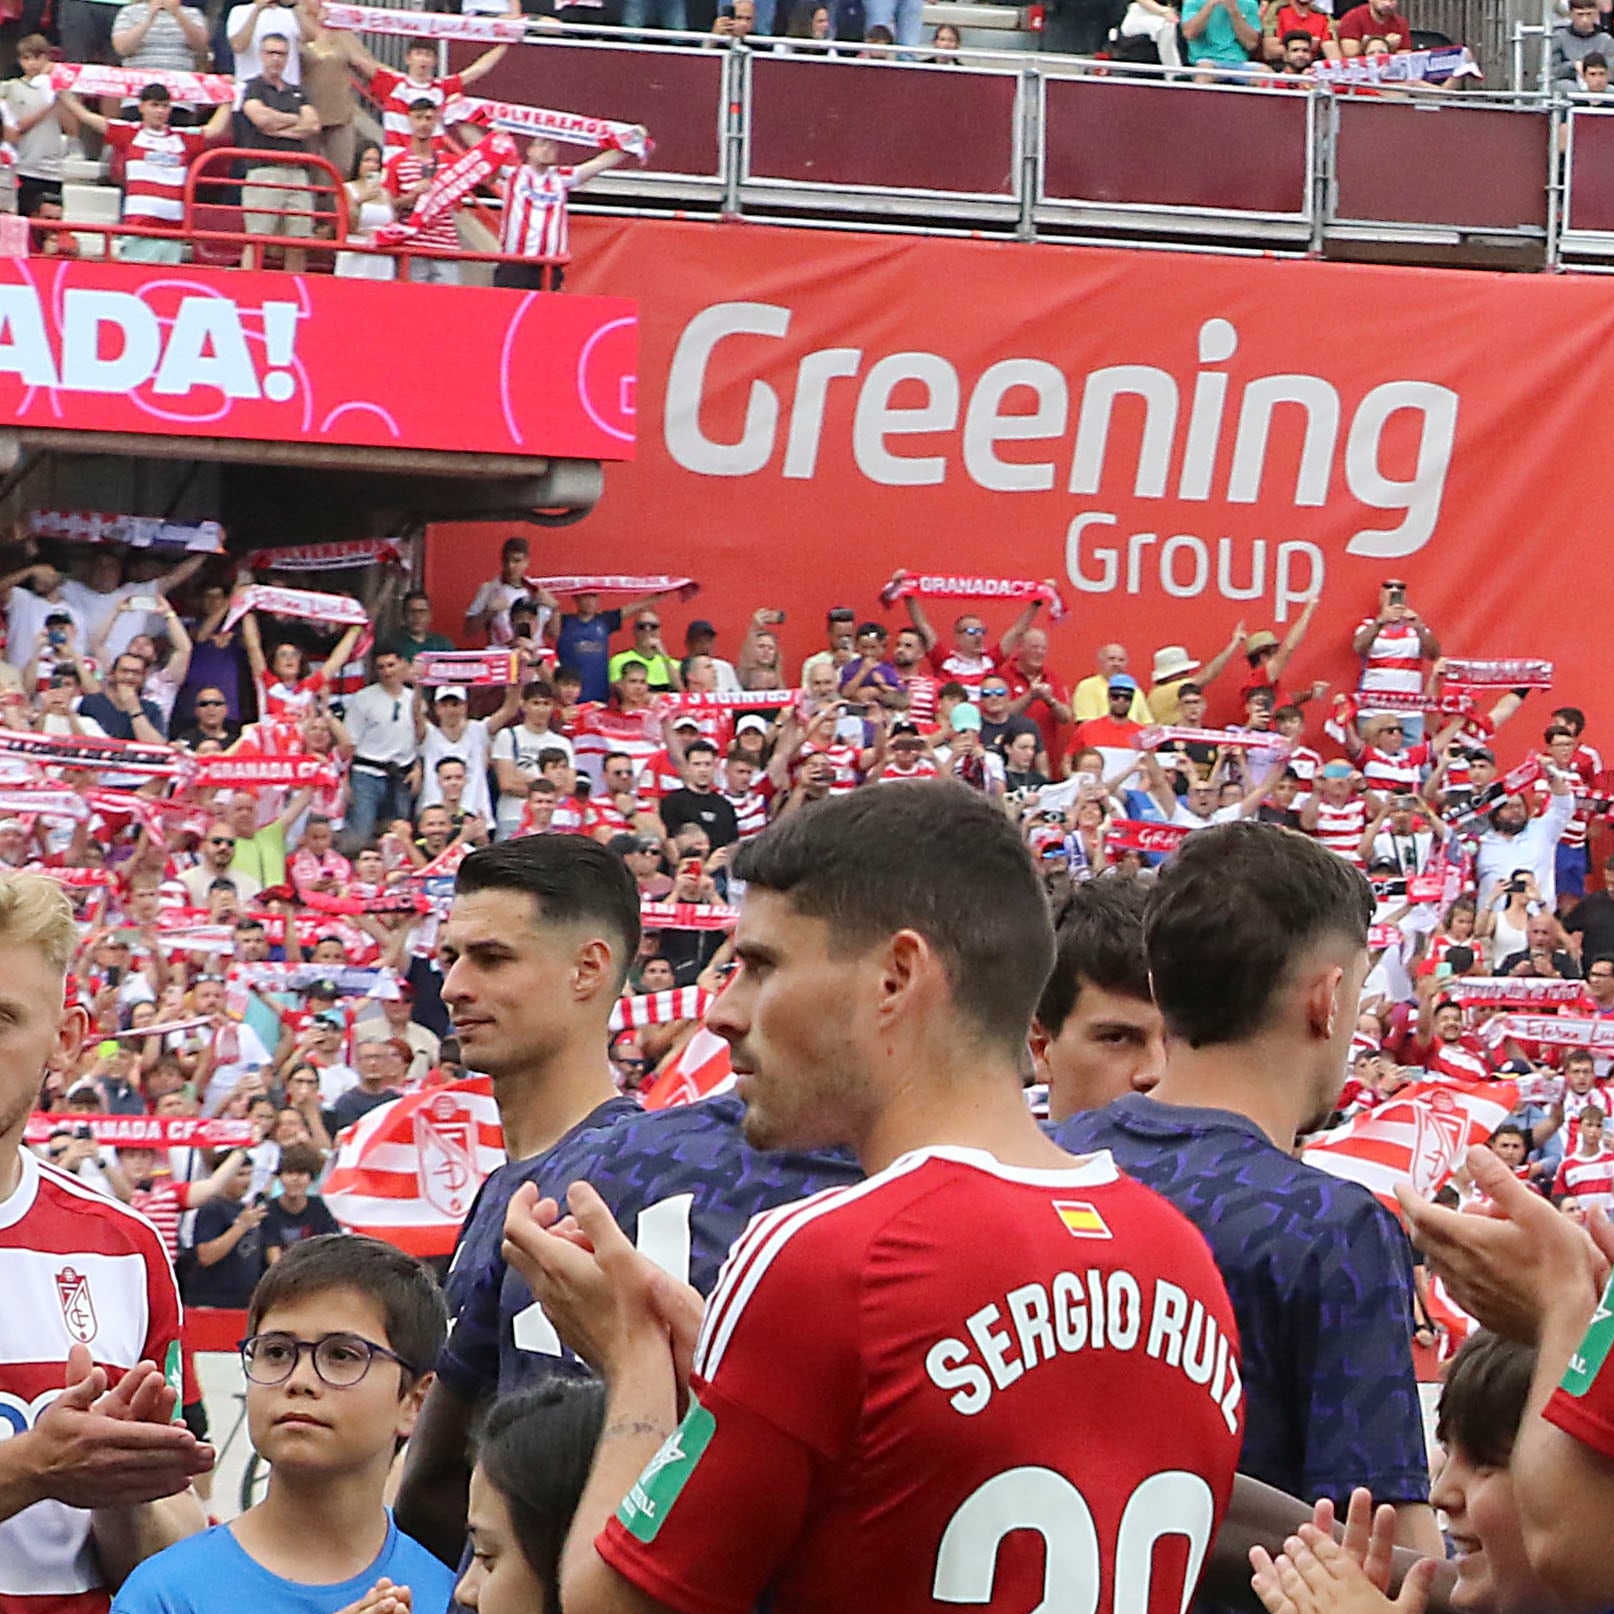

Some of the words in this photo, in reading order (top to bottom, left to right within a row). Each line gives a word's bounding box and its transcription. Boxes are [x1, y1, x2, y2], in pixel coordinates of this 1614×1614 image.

[662, 301, 1459, 557] Greening
[1065, 509, 1325, 623] Group
[167, 1120, 197, 1139] CF
[926, 1270, 1142, 1415] SERGIO
